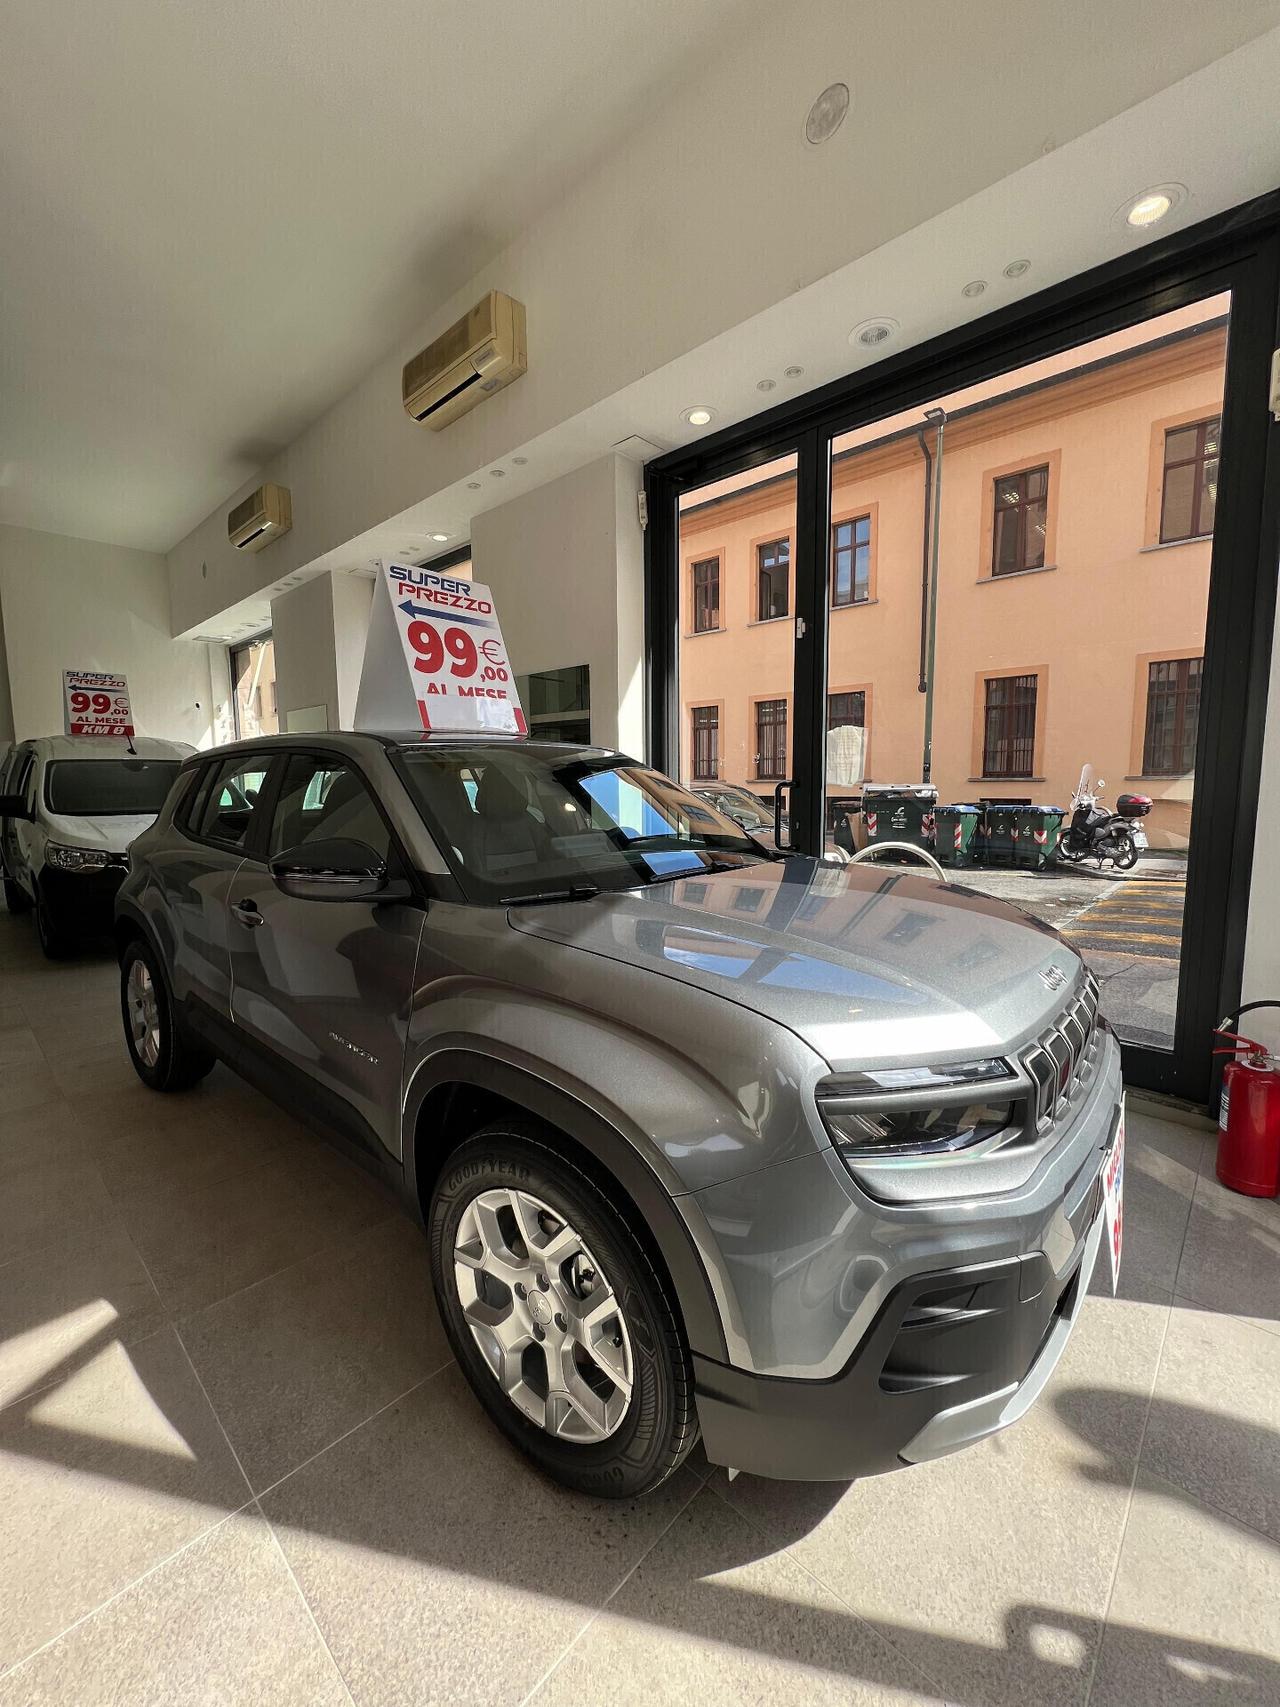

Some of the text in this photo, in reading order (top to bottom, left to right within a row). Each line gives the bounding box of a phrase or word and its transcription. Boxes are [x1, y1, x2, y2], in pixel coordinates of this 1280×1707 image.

[389, 565, 471, 596] SUPER
[398, 582, 492, 615] PREZZO
[407, 620, 479, 678] 99
[66, 671, 114, 680] SUPER
[69, 678, 126, 688] PREZZO
[70, 692, 112, 714] 99
[81, 725, 110, 734] KM
